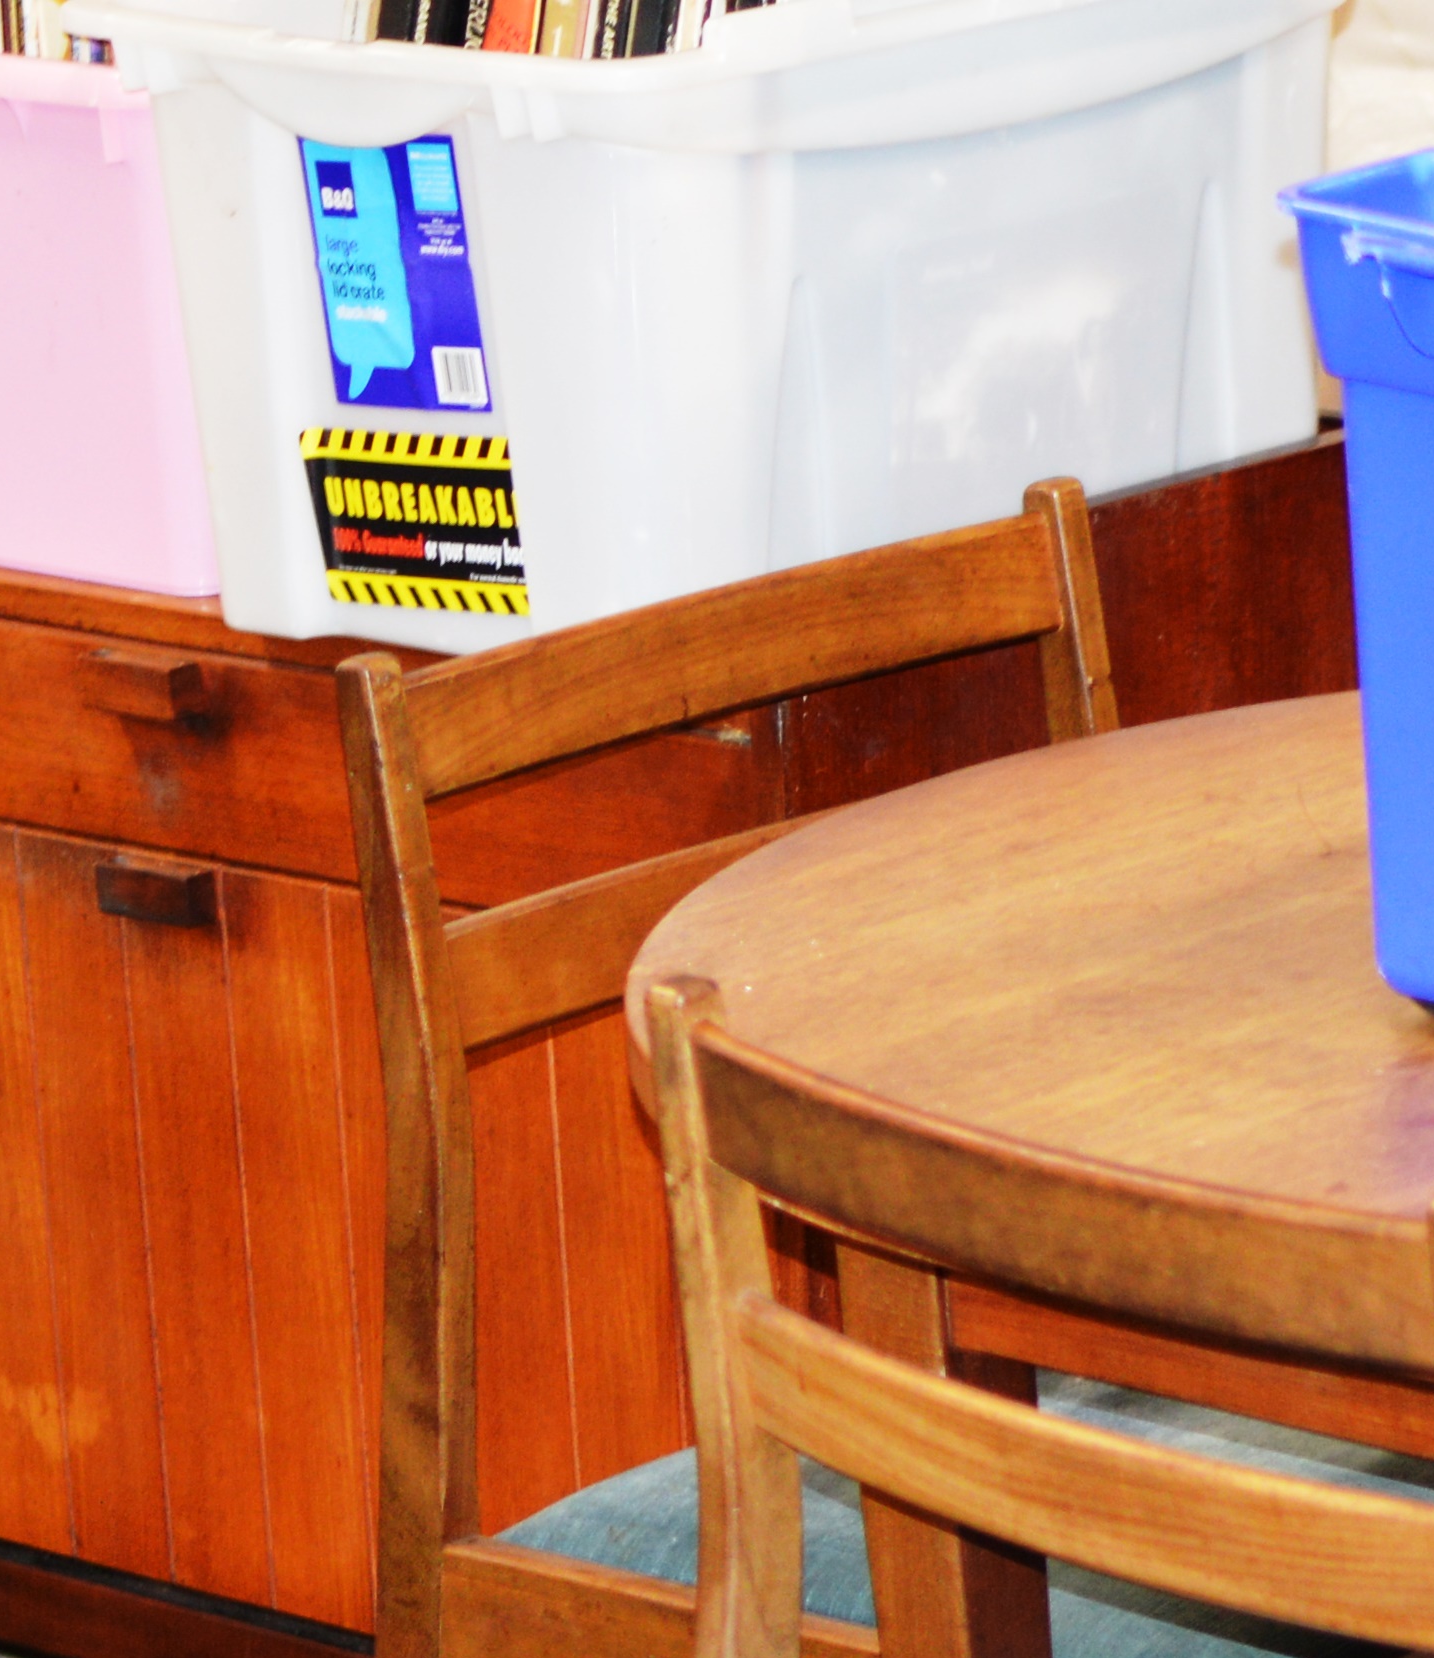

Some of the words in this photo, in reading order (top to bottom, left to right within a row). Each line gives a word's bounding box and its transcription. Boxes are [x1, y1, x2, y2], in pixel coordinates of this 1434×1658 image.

[320, 186, 355, 212] B&Q
[325, 236, 359, 257] large
[326, 258, 377, 282] locking
[333, 282, 348, 299] lid
[349, 284, 385, 301] crate
[324, 476, 519, 529] UNBREAKABL
[424, 540, 438, 561] or
[438, 541, 465, 567] your
[465, 542, 503, 571] money
